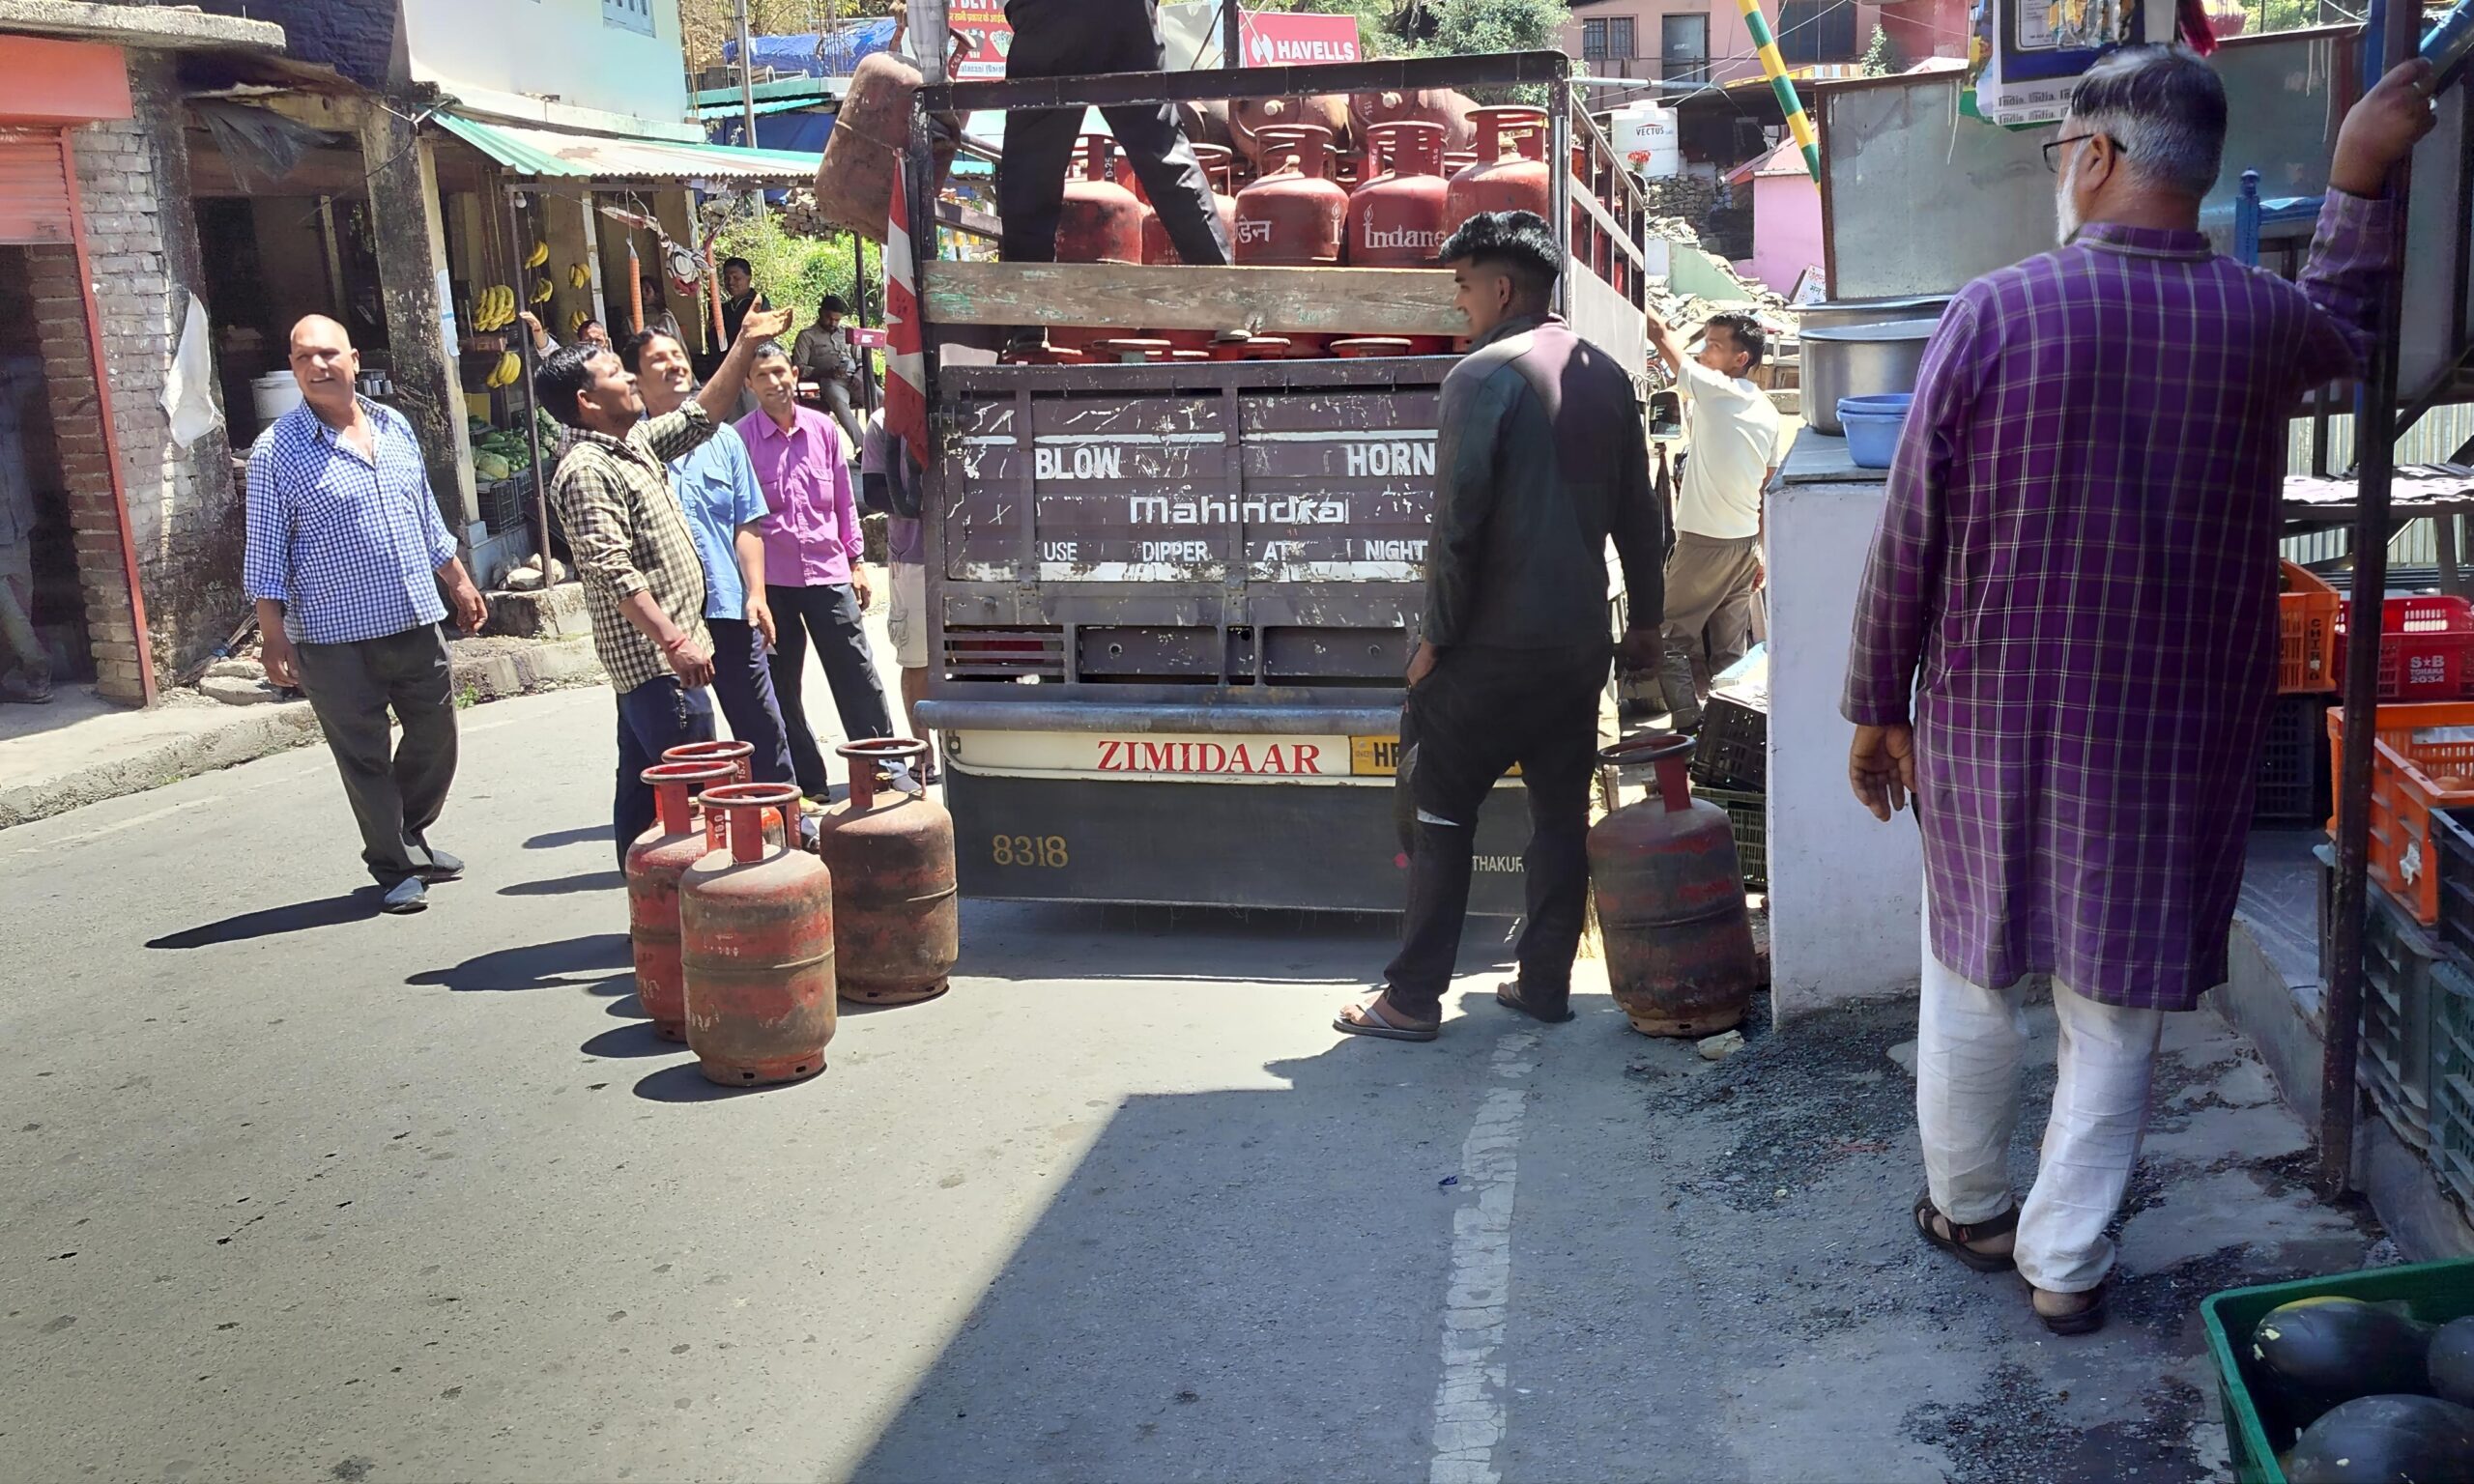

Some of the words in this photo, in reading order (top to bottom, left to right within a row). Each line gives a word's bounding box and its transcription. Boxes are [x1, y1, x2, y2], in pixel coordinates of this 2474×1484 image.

[1277, 41, 1355, 61] HAVELLS
[1636, 126, 1664, 136] VECTUS
[1035, 448, 1121, 479] BLOW
[1346, 442, 1435, 476] HORN
[1044, 542, 1078, 561] USE
[1142, 541, 1208, 562] DIPPER
[1262, 541, 1289, 561] AT
[1366, 540, 1428, 561] NIGHT
[1098, 740, 1322, 774] ZIMIDAAR
[992, 834, 1069, 868] 8318
